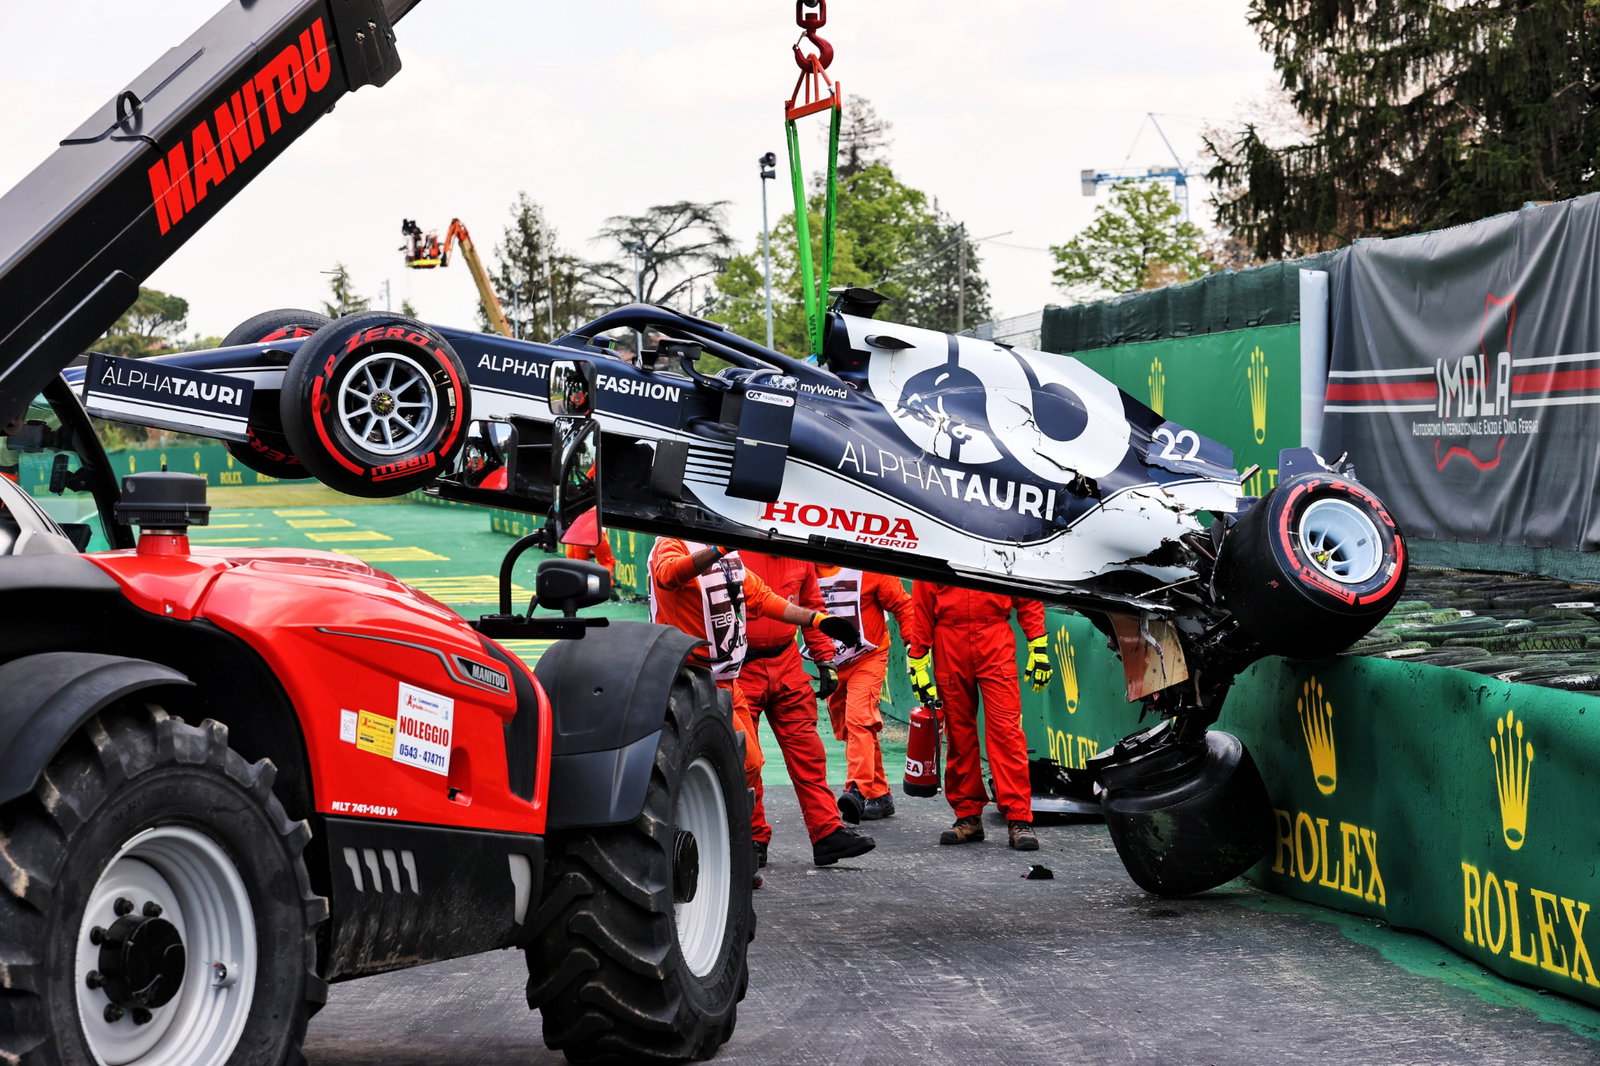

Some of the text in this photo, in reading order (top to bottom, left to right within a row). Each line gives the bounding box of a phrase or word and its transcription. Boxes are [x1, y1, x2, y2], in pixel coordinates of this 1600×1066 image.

[148, 17, 331, 236] MANITOU
[324, 326, 430, 378] P ZERO
[101, 366, 243, 406] ALPHATAURI
[477, 353, 681, 403] ALPHAT FASHION
[800, 383, 848, 399] myWorld
[1436, 352, 1511, 418] IMOLA
[1152, 428, 1205, 463] 22
[371, 452, 437, 482] PIRELLI
[837, 441, 1056, 521] ALPHATAURI
[760, 500, 919, 541] HONDA
[1307, 480, 1320, 493] P
[1329, 480, 1396, 527] ZERO
[855, 535, 918, 549] HYBRID
[472, 664, 505, 688] MANITOU
[399, 715, 449, 747] NOLEGGIO
[399, 743, 418, 759] 0543
[422, 751, 445, 767] 474711
[906, 761, 920, 774] EA
[331, 801, 398, 816] MLT 741-140 V+
[1271, 808, 1387, 907] ROLEX
[1461, 861, 1600, 988] ROLEX
